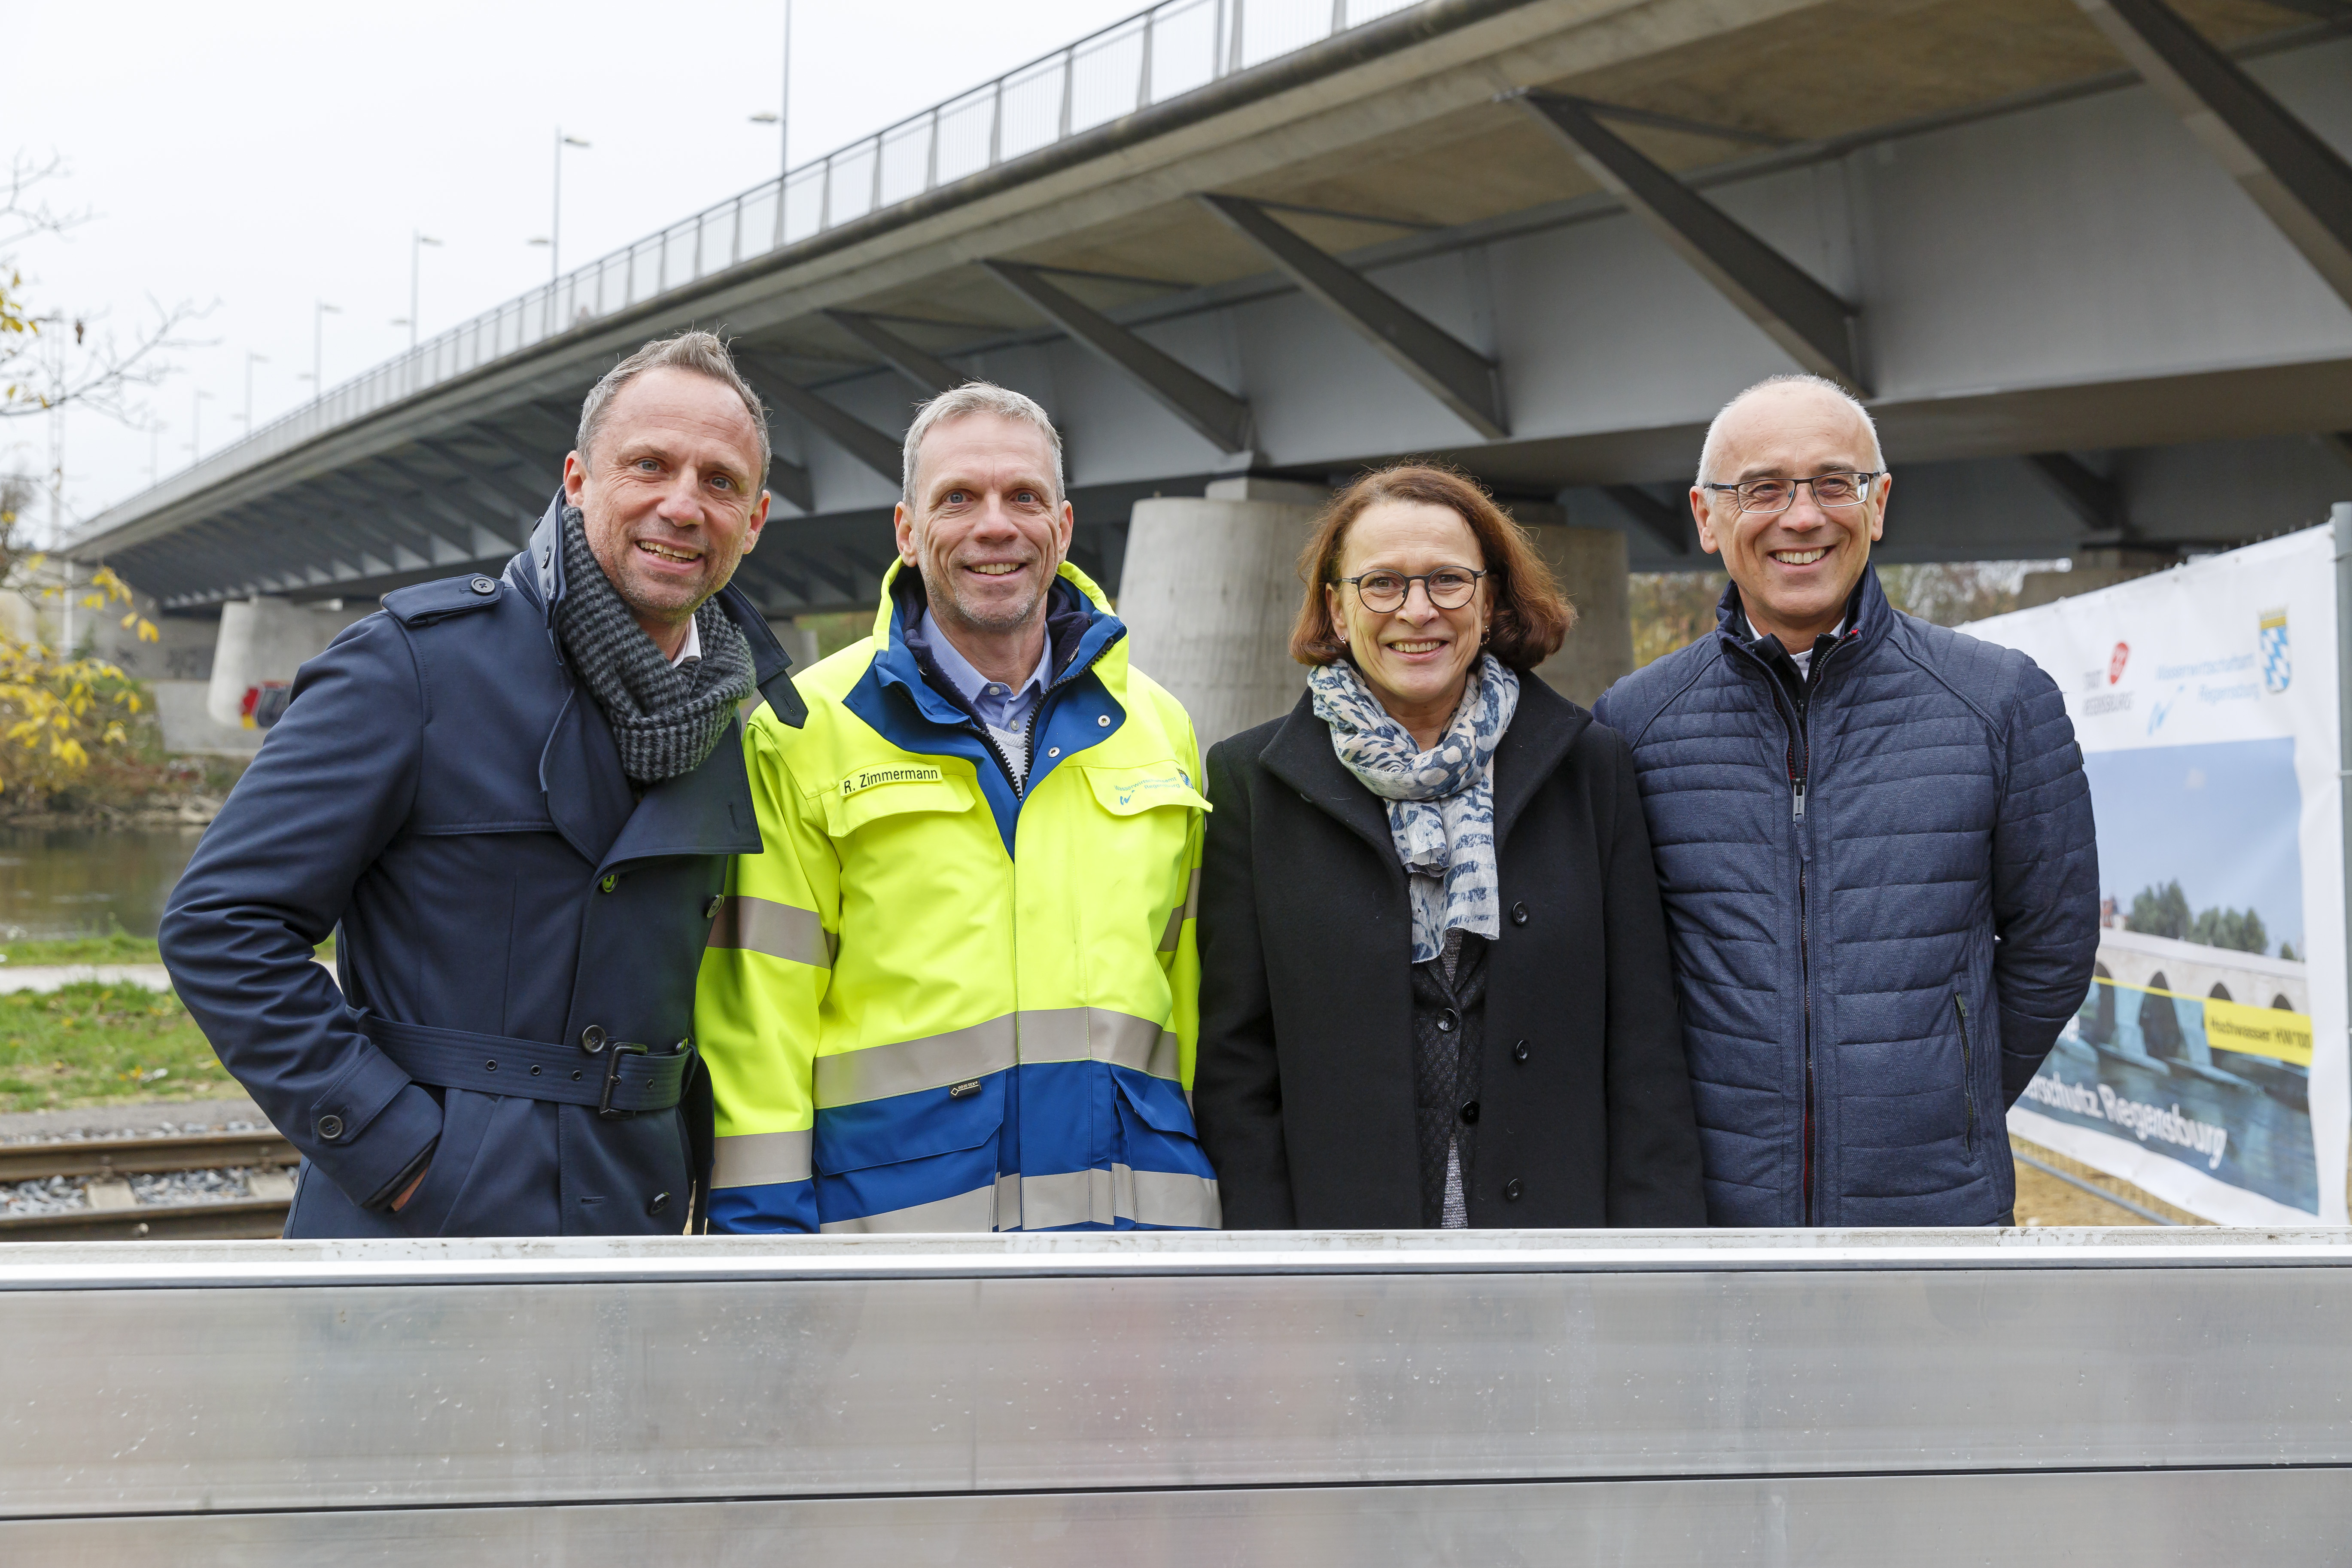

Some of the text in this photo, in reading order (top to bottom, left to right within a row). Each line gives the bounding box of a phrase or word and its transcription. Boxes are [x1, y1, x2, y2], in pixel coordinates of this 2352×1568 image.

[844, 770, 938, 794] R. Zimmermann
[1114, 777, 1177, 791] Wasserwirtschaftsamt
[2096, 1083, 2227, 1170] Regensburg
